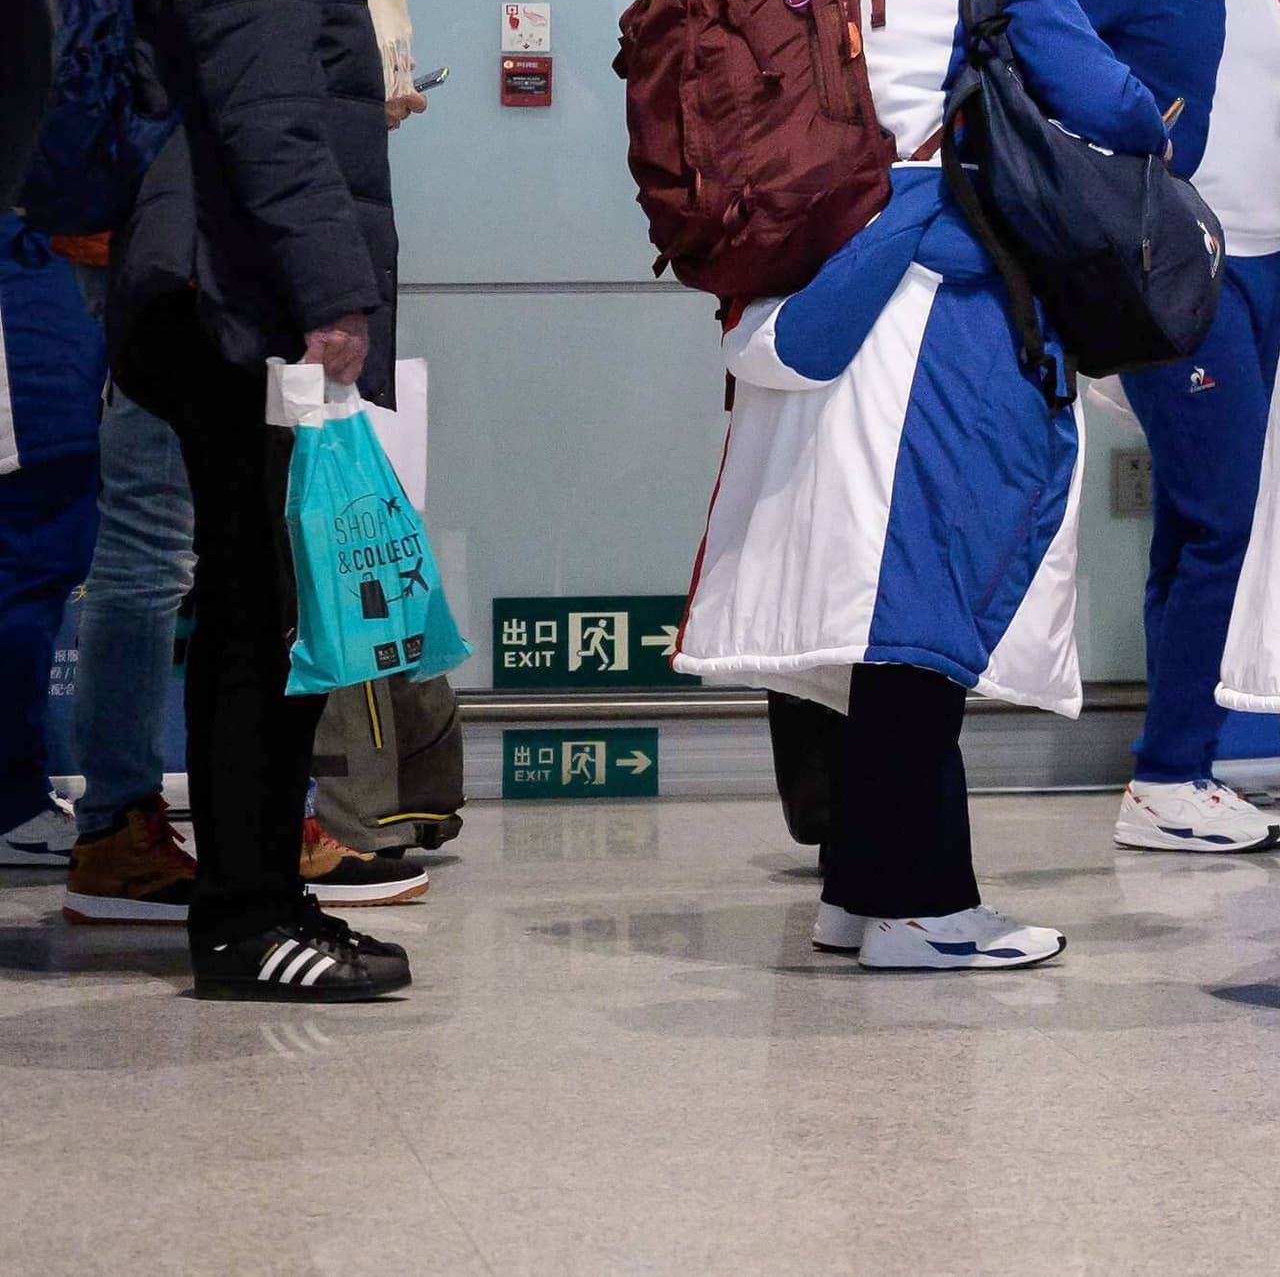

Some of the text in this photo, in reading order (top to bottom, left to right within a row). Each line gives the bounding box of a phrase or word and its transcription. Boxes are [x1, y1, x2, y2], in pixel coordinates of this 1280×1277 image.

[502, 618, 557, 646] 出口
[504, 650, 555, 668] EXIT
[514, 746, 554, 767] 出口
[514, 769, 552, 782] EXIT
